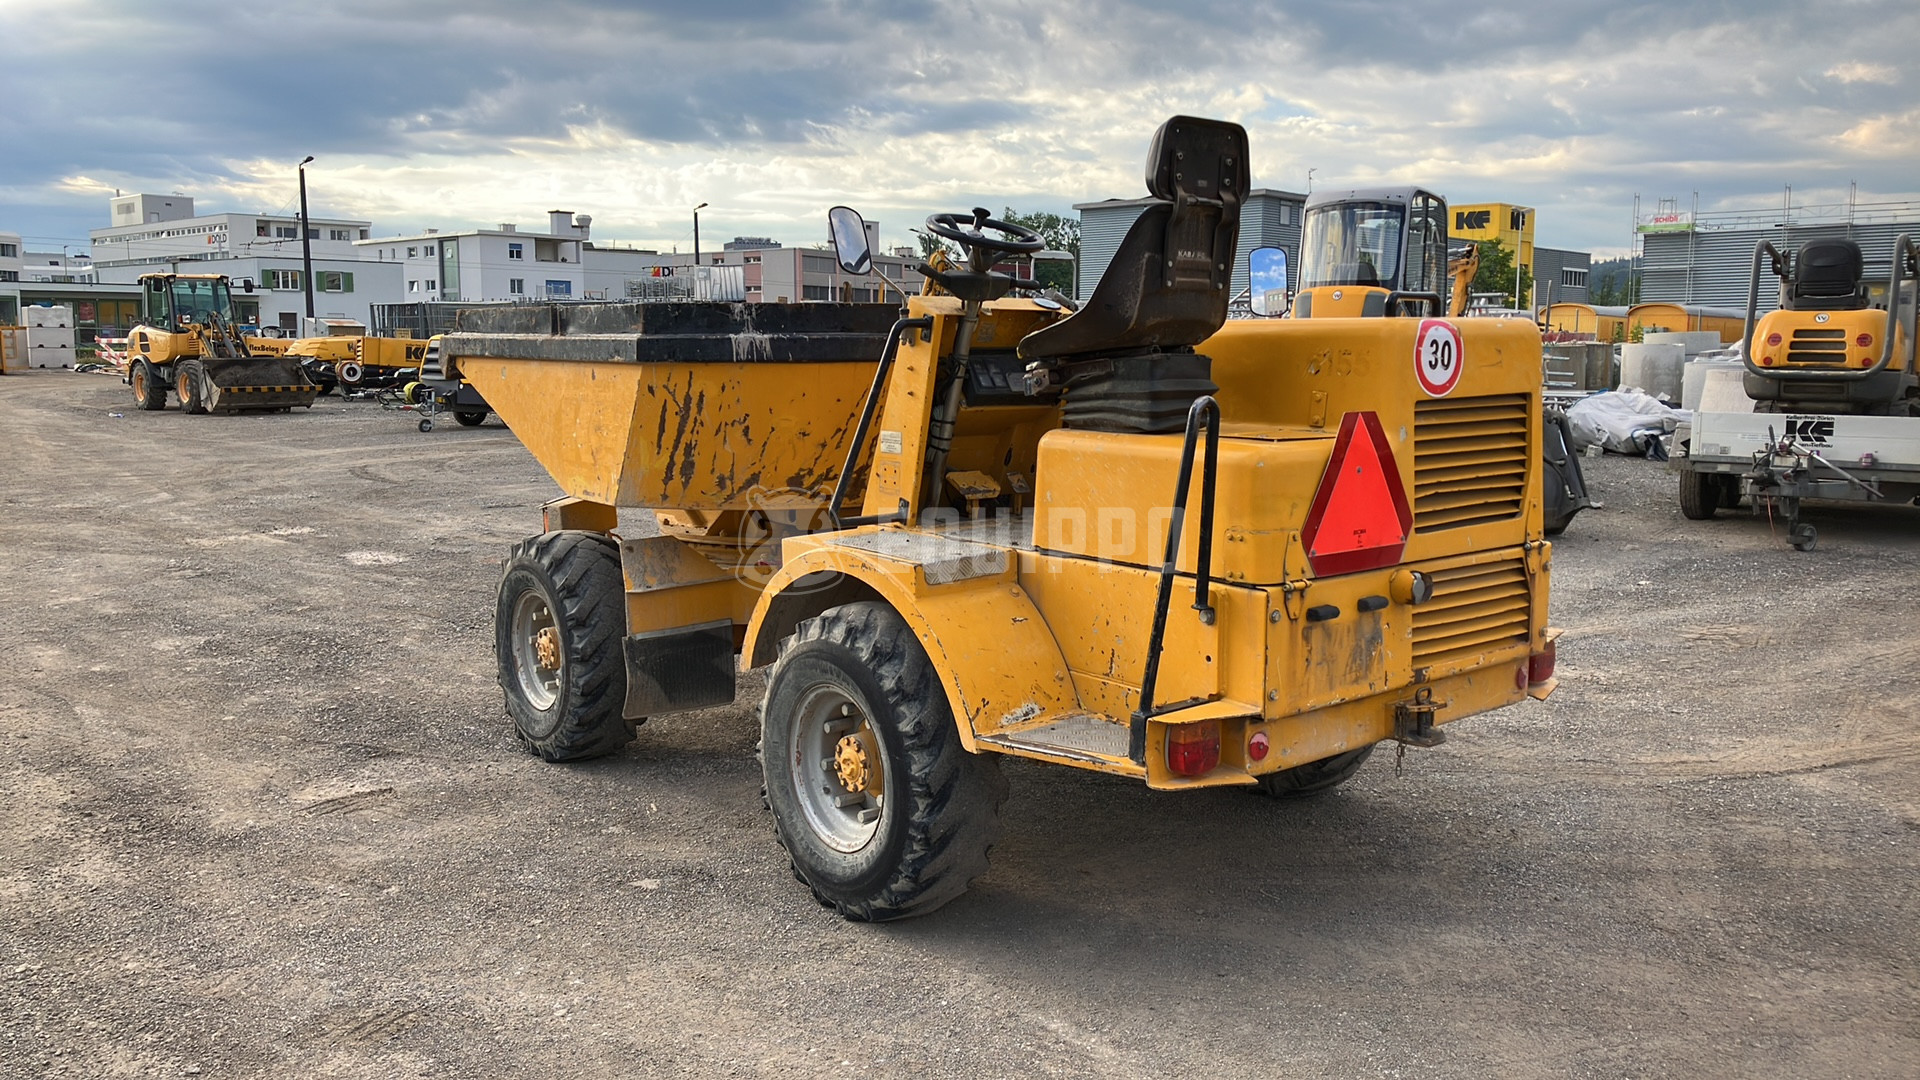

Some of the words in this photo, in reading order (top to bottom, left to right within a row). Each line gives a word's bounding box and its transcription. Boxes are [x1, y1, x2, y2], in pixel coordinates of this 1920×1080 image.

[1456, 210, 1490, 230] KF
[662, 267, 674, 277] D
[1428, 338, 1452, 371] 30
[1786, 420, 1834, 442] KF
